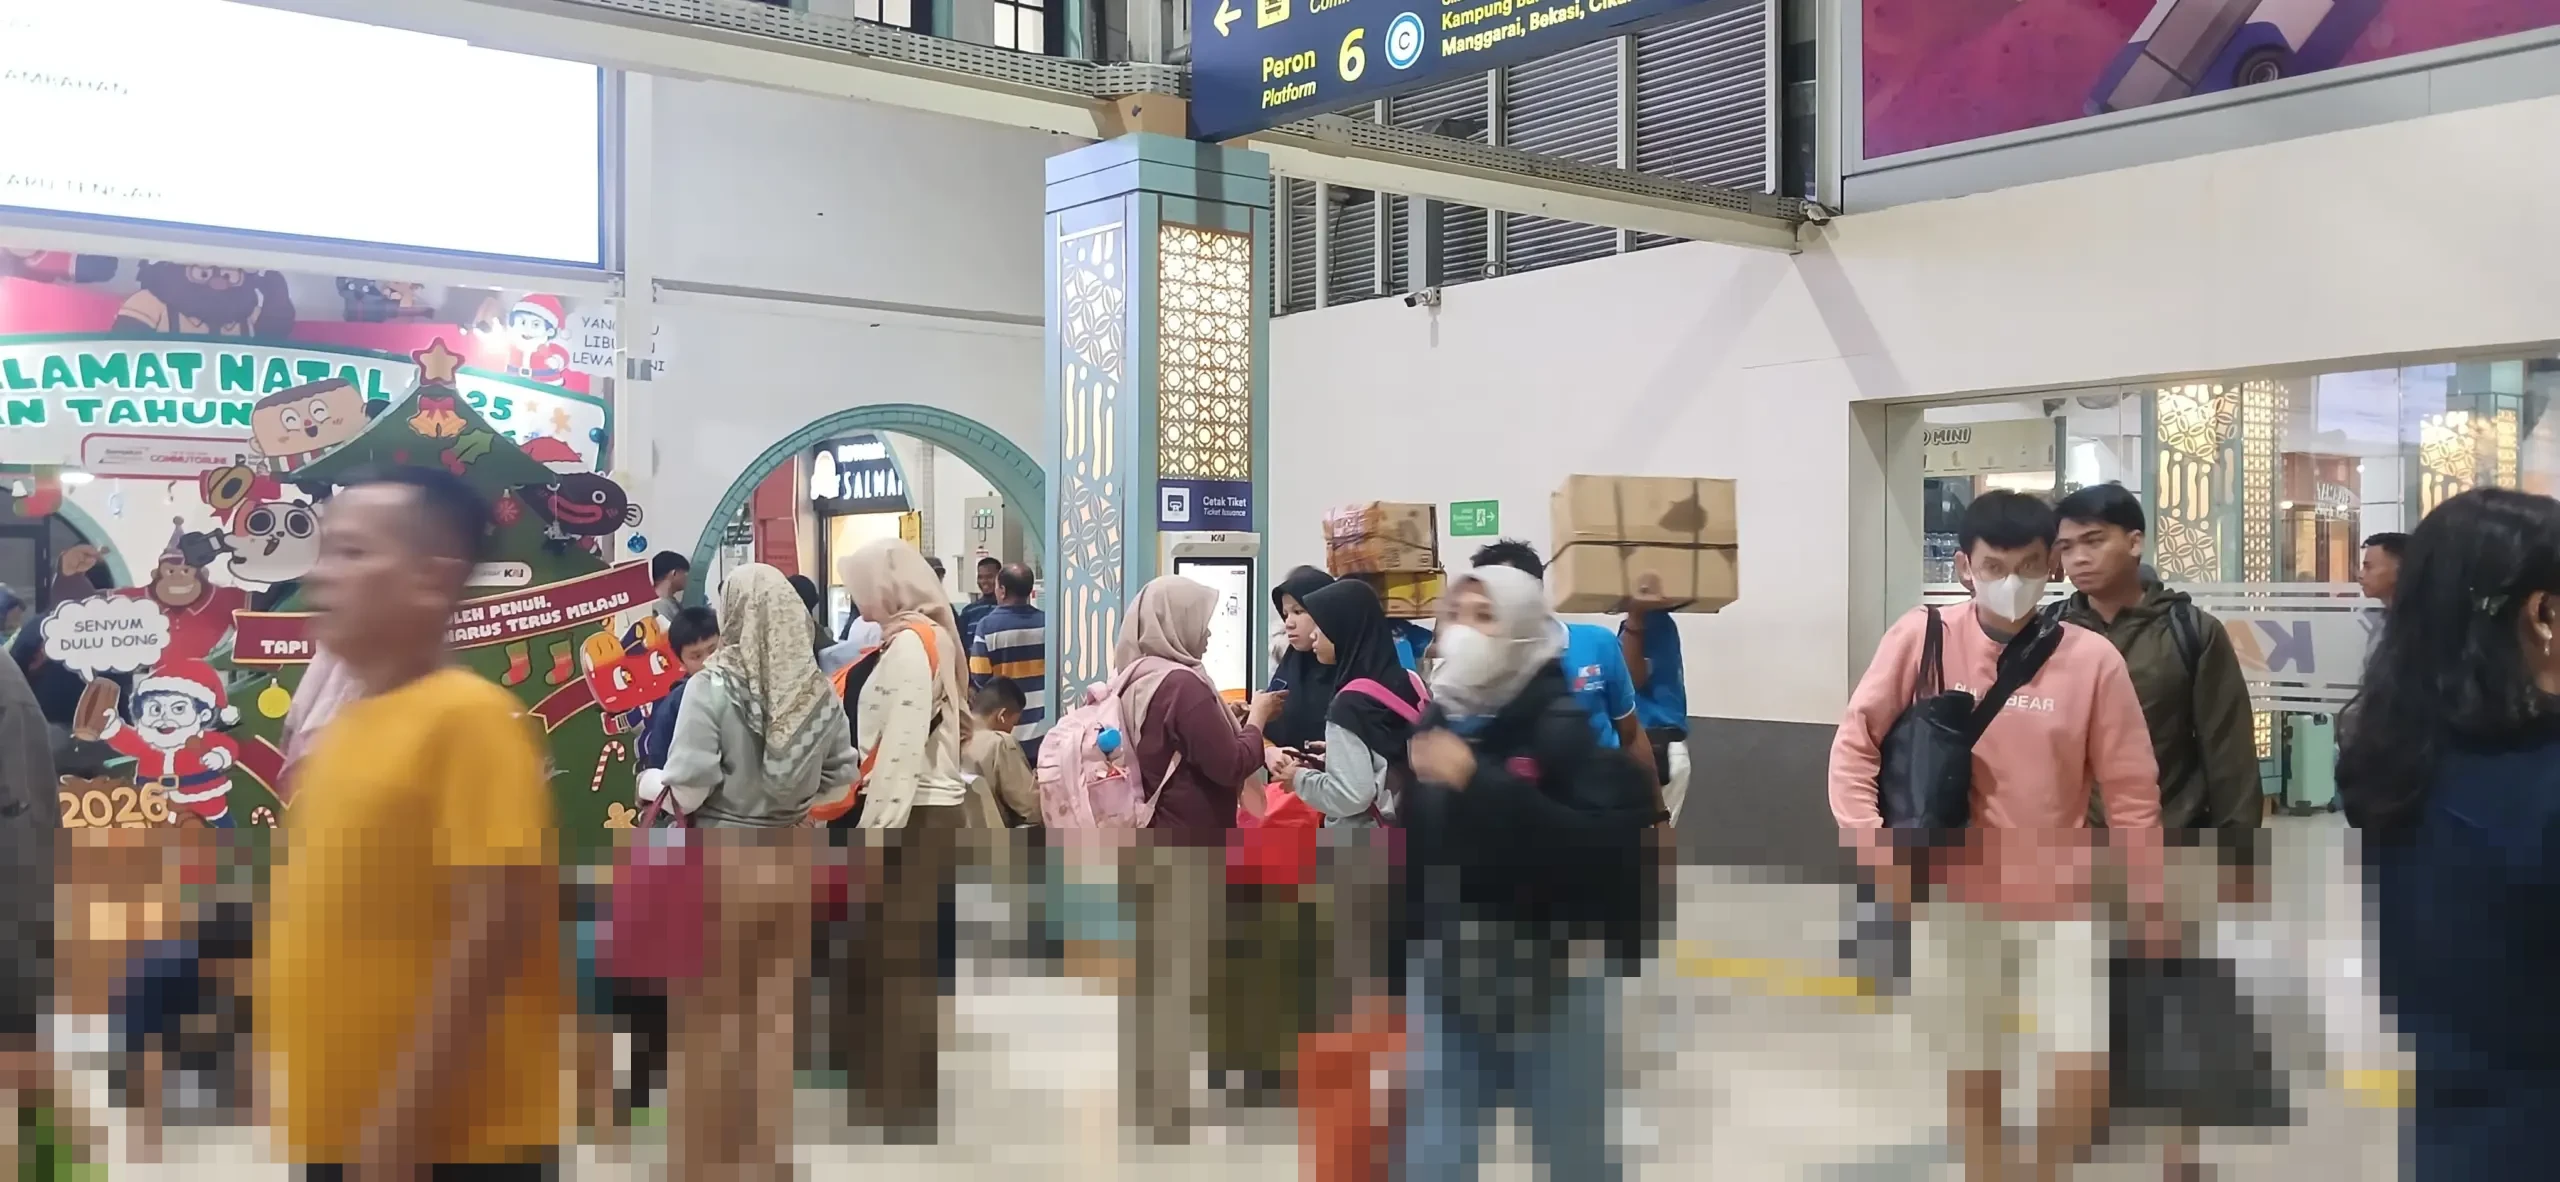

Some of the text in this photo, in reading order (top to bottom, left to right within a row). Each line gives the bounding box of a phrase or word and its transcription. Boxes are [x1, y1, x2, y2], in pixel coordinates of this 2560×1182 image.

[1442, 2, 1512, 30] Kampung
[1442, 17, 1525, 56] Manggarai,
[1530, 0, 1585, 30] Bekasi,
[1398, 31, 1410, 50] C
[1262, 50, 1316, 82] Peron
[1339, 28, 1365, 82] 6
[1261, 81, 1317, 109] Platform
[0, 352, 202, 390] LAMAT
[0, 398, 46, 426] N
[66, 399, 253, 425] TAHUN
[1933, 427, 1971, 445] MINI
[1202, 496, 1247, 507] Cetak Tiket
[1203, 507, 1221, 516] Ticket
[1211, 534, 1225, 542] KAI
[489, 595, 552, 618] PENUH.
[506, 610, 562, 633] TERUS
[566, 592, 630, 620] MELAJU
[74, 618, 144, 633] SENYUM
[60, 633, 158, 650] DULU DONG
[260, 639, 308, 654] TAPI
[59, 781, 169, 828] 2026
